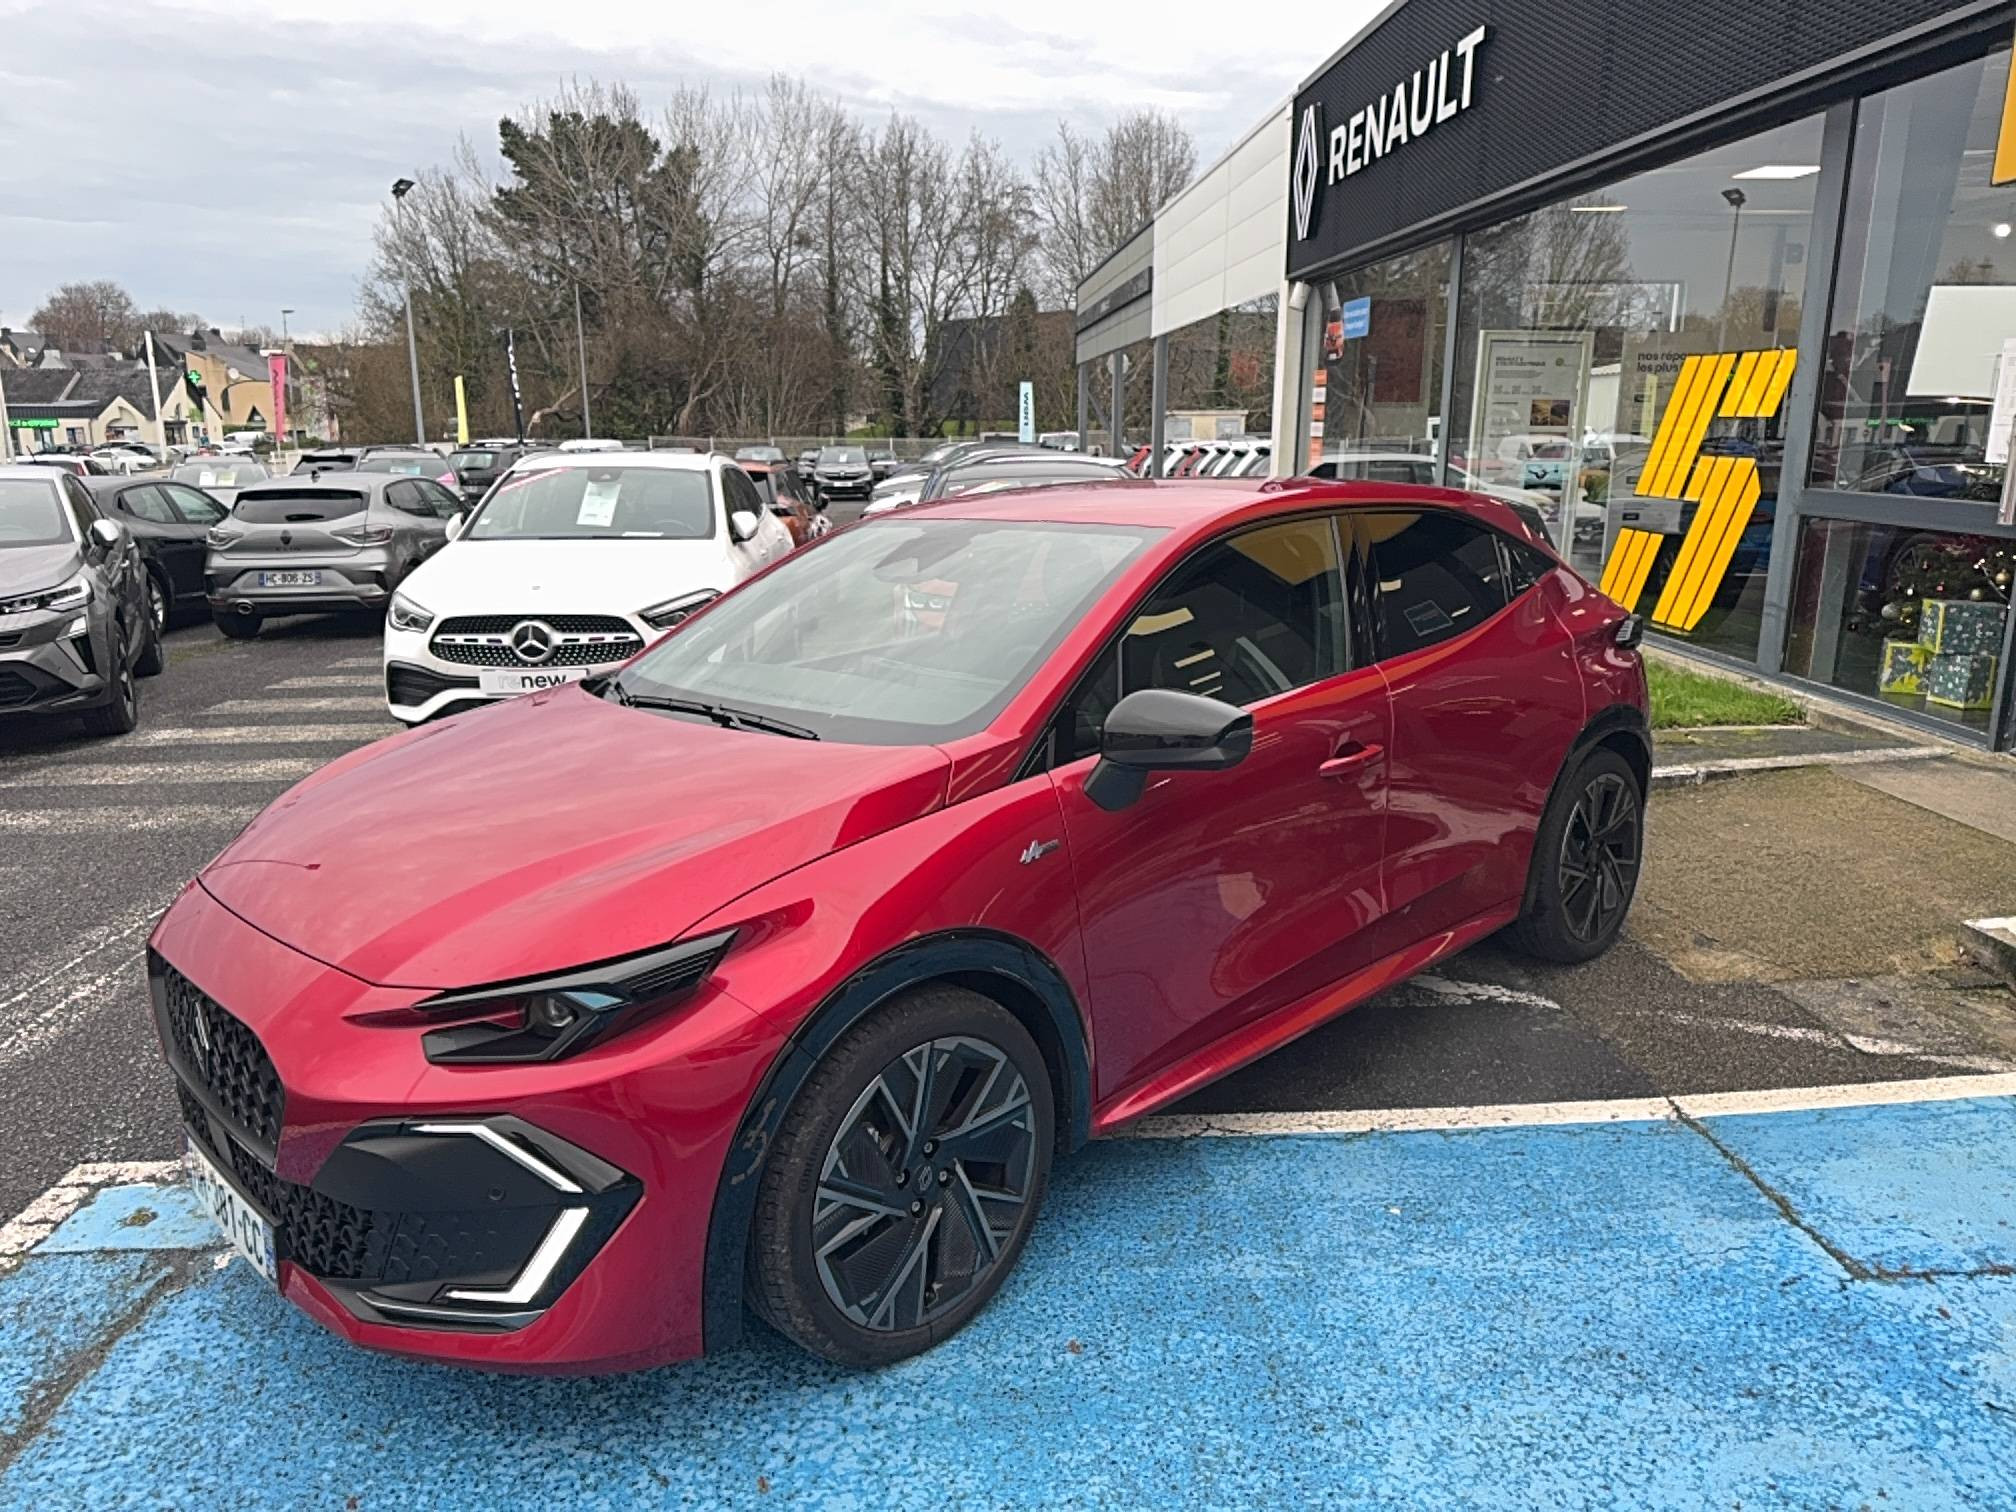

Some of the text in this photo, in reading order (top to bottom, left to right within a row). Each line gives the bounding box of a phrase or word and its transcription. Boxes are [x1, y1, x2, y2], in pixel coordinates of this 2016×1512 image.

[1328, 25, 1486, 186] RENAULT
[1637, 353, 1659, 361] nos
[1655, 362, 1679, 375] plus
[498, 674, 567, 689] renew
